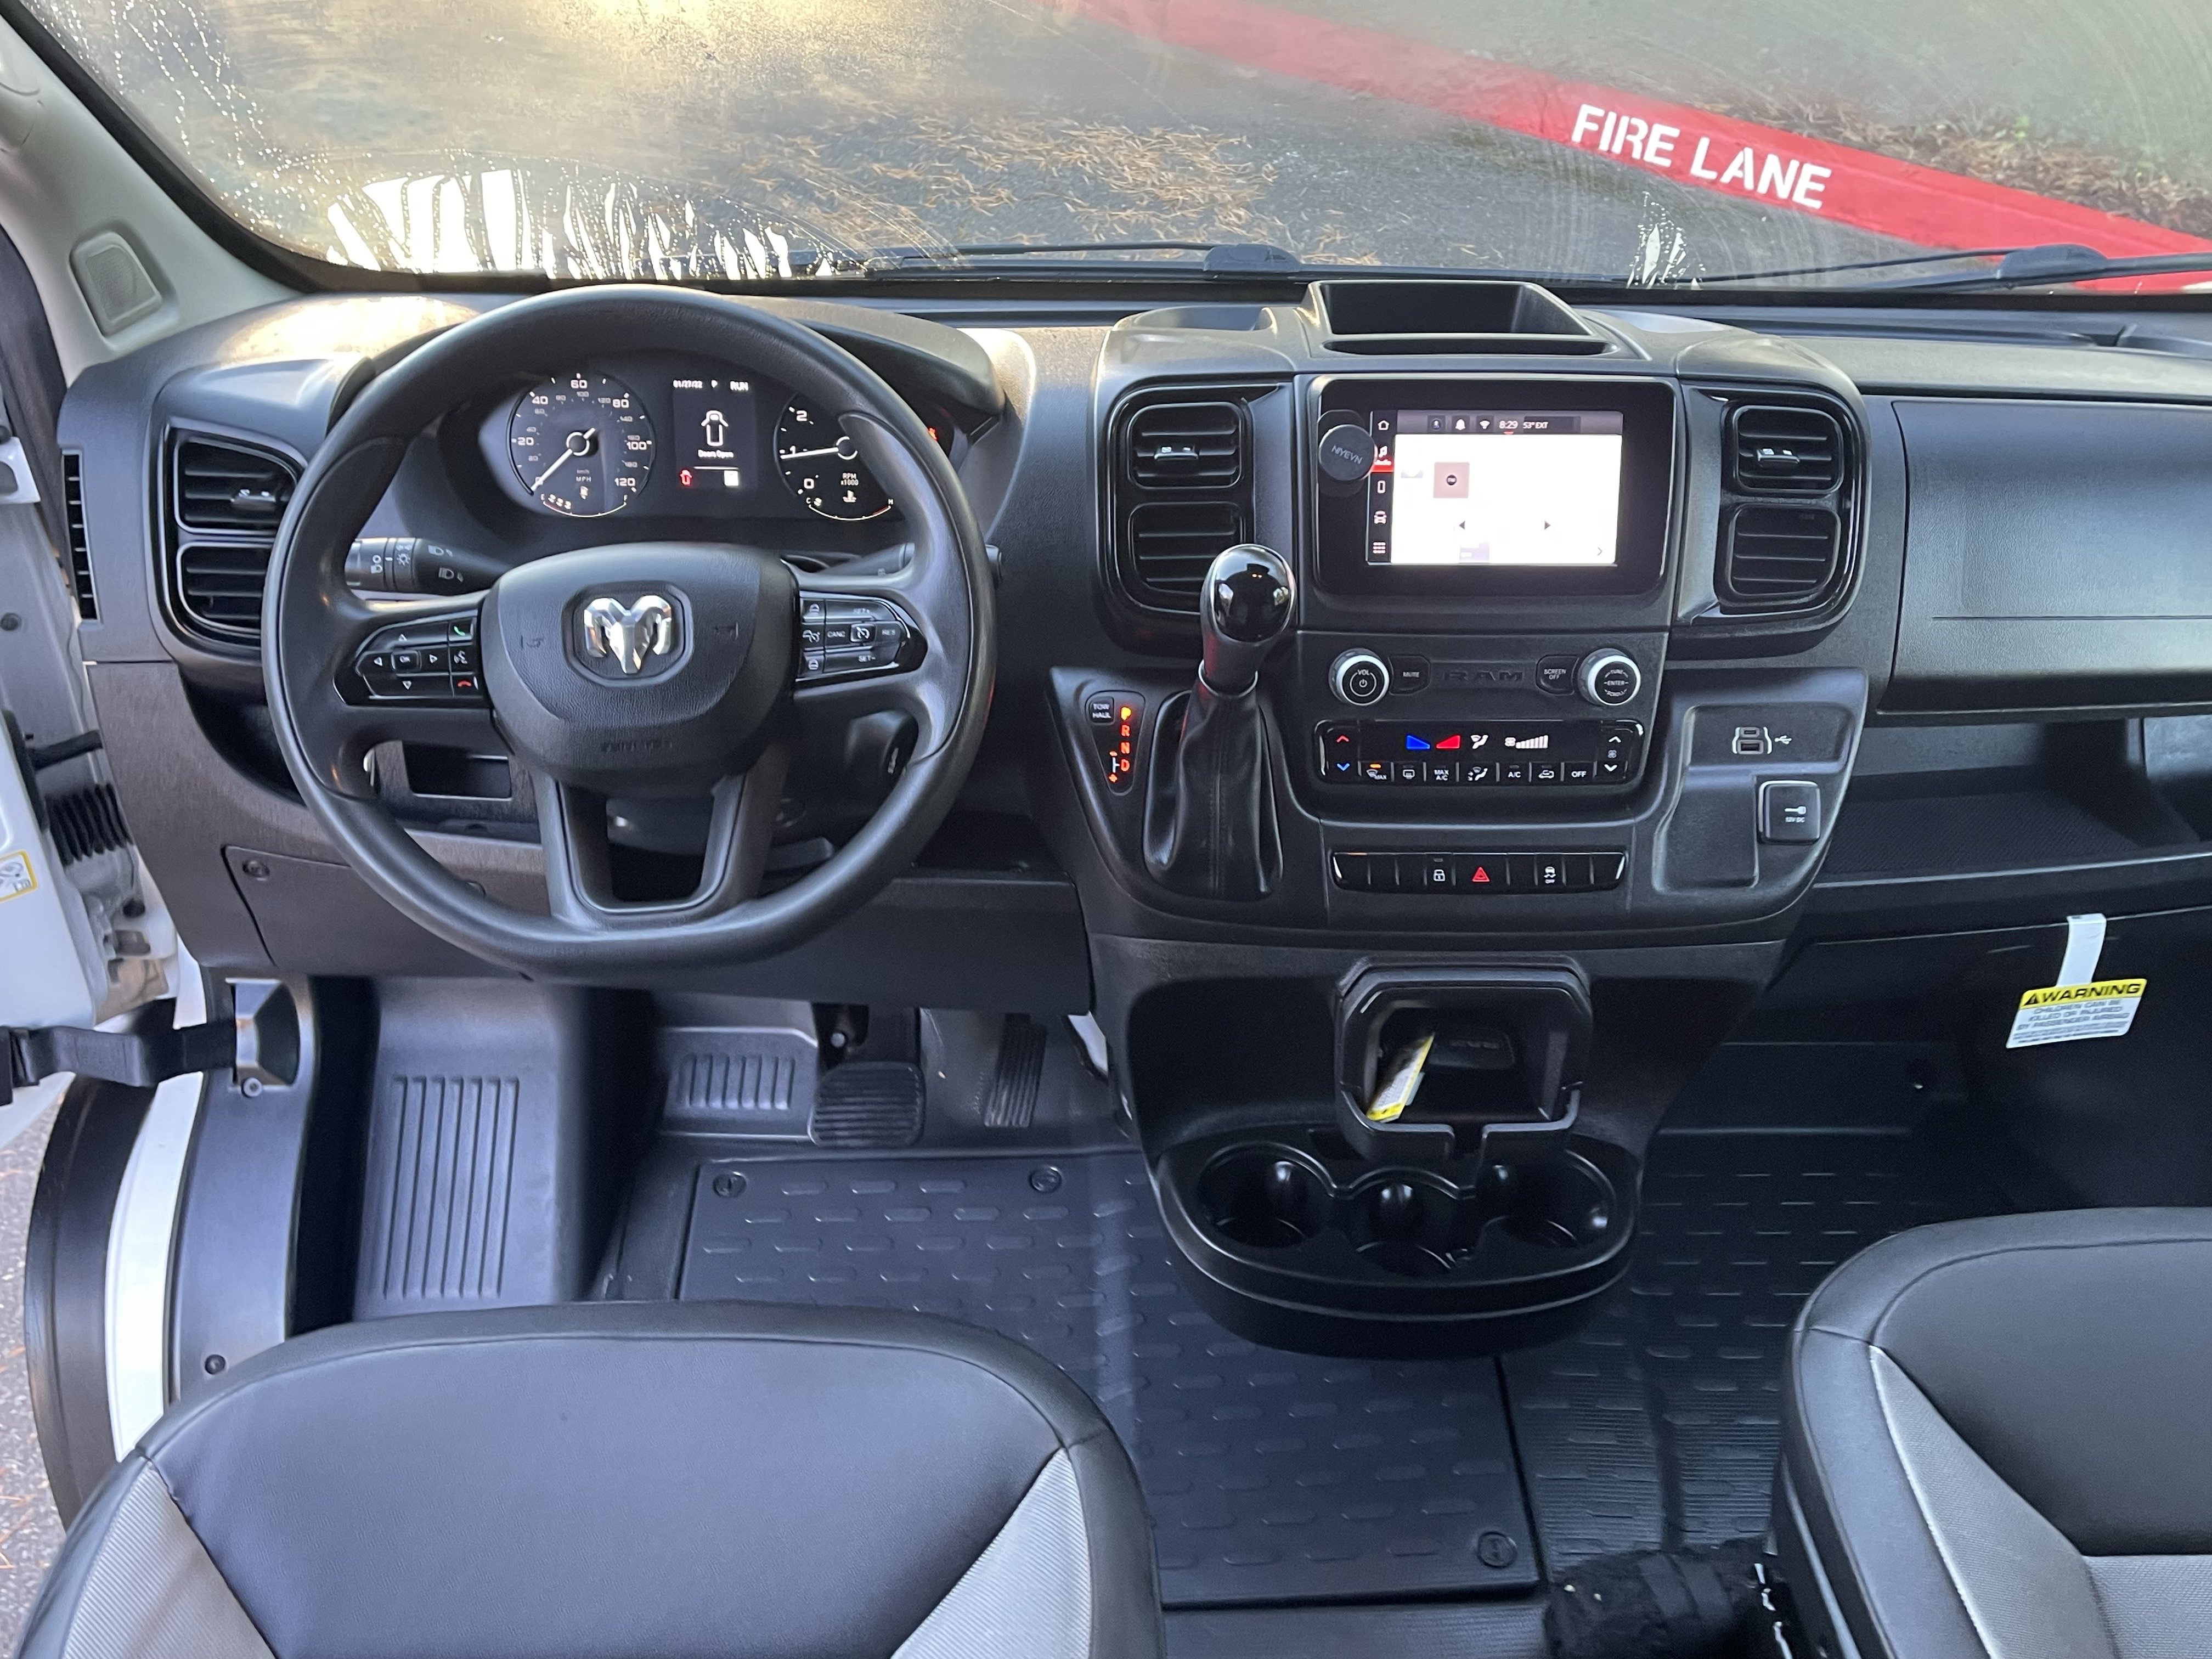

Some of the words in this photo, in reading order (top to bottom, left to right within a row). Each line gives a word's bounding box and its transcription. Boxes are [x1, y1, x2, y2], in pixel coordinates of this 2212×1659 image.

[1571, 104, 1680, 168] FIRE
[1690, 137, 1832, 210] LANE
[571, 379, 588, 389] 60
[730, 381, 749, 391] RUN
[532, 396, 548, 405] 40
[612, 398, 629, 408] 80
[796, 410, 808, 422] 2
[1499, 420, 1519, 429] 8:29
[517, 437, 534, 445] 20
[627, 441, 647, 450] 100
[790, 445, 795, 455] 1
[1331, 444, 1363, 465] NIYEVN
[614, 478, 636, 487] 120
[803, 478, 815, 489] 0
[1444, 670, 1523, 682] RAM
[1120, 706, 1132, 720] P
[1121, 724, 1131, 737] R
[1120, 742, 1131, 754] N
[1120, 758, 1130, 772] D
[2044, 984, 2142, 1002] WARNING
